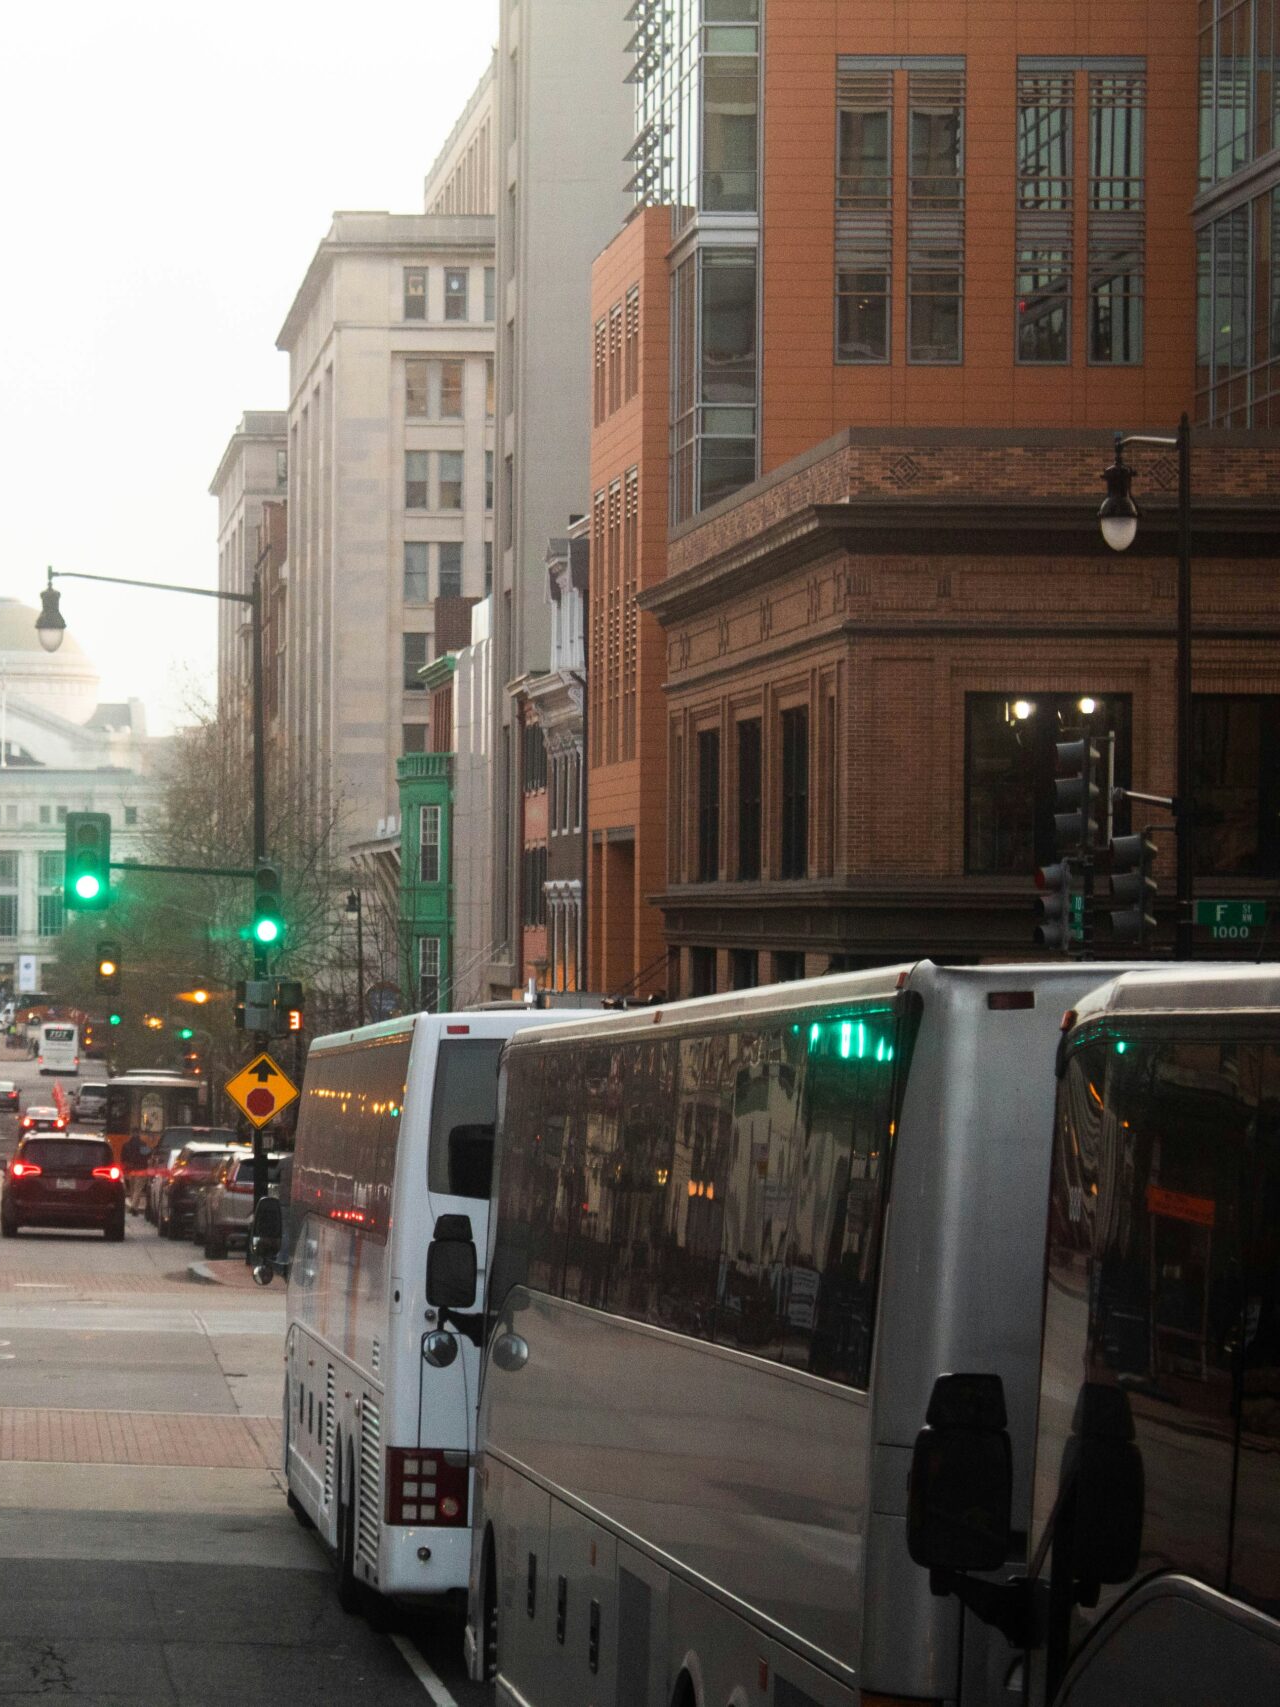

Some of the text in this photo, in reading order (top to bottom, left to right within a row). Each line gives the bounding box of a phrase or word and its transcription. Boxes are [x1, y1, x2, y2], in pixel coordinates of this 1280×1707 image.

[1216, 904, 1229, 922] F
[1213, 926, 1249, 938] 1000
[289, 1010, 301, 1030] 3
